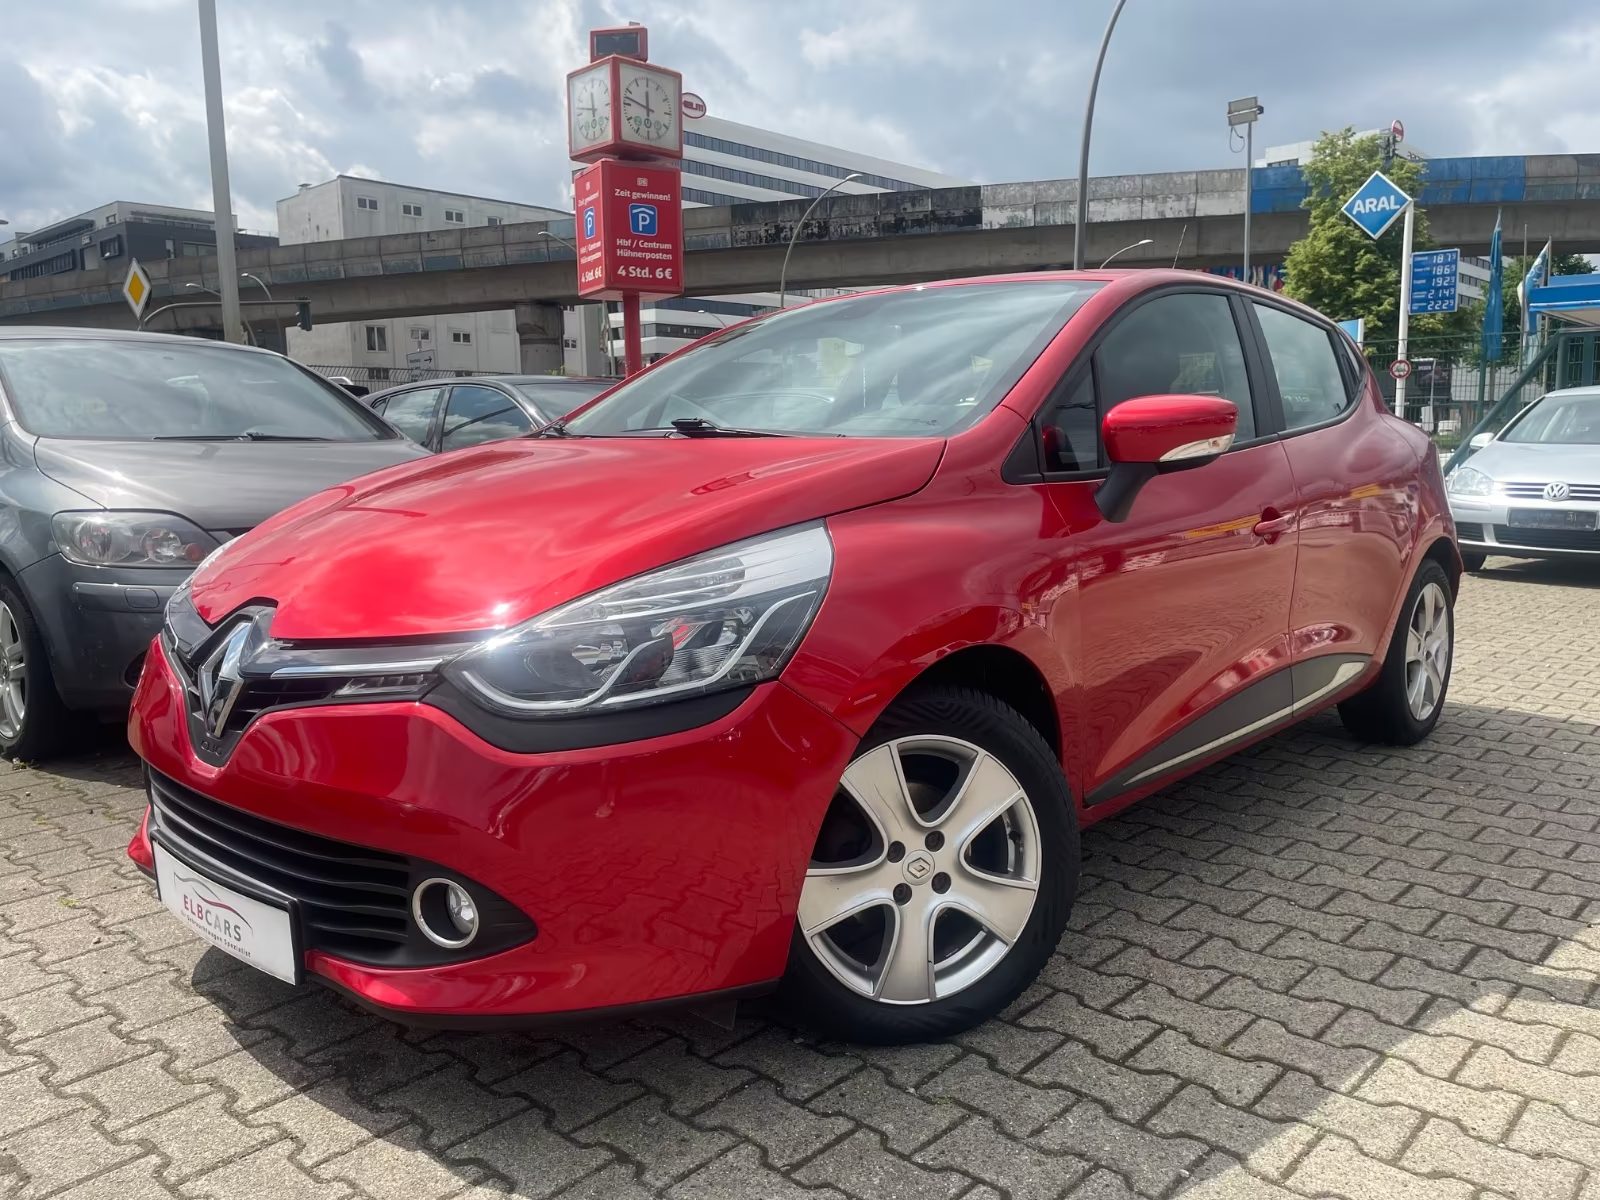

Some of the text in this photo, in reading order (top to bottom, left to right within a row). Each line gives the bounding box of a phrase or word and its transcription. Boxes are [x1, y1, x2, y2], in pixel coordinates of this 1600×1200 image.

[614, 188, 671, 201] Zeit gewinnen!
[1352, 195, 1400, 215] ARAL
[616, 238, 631, 247] Hbf
[638, 240, 672, 250] Centrum
[616, 248, 673, 260] Hühnerposten
[617, 265, 673, 280] 4 Std. 6€
[183, 894, 242, 942] ELBCARS
